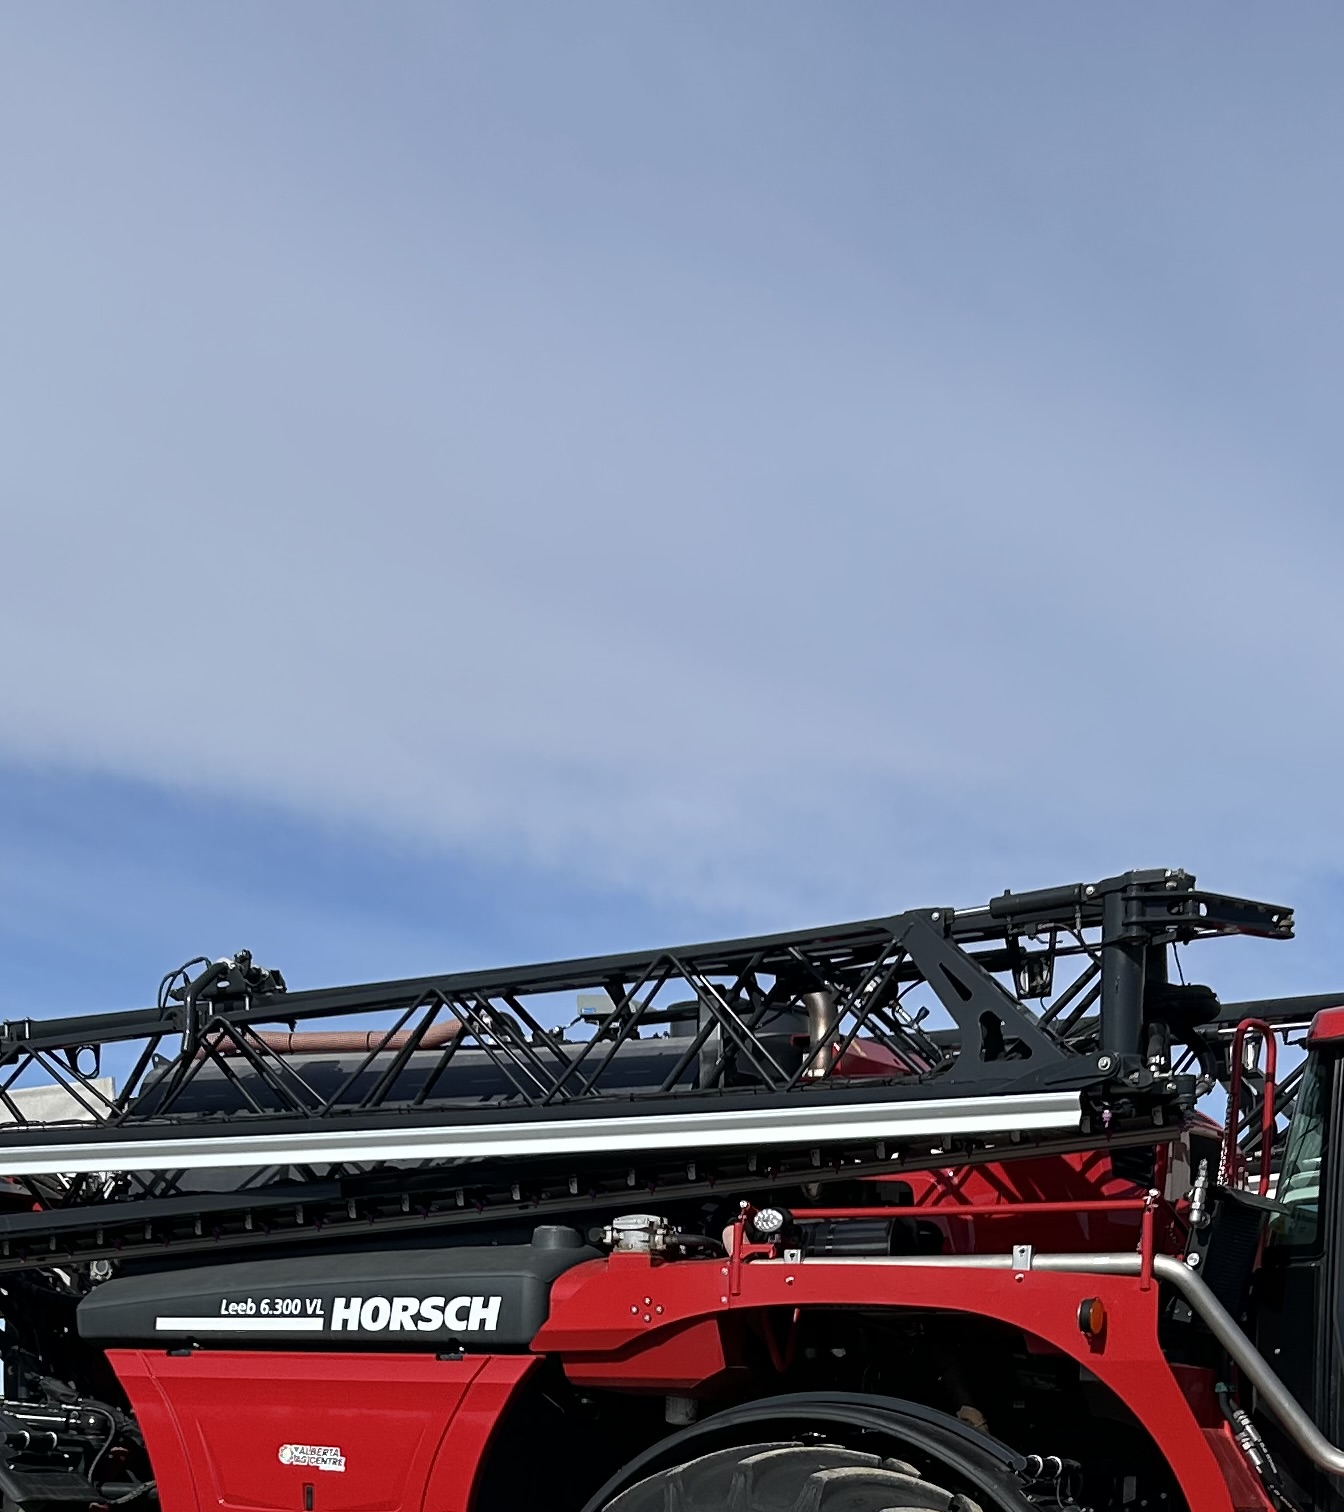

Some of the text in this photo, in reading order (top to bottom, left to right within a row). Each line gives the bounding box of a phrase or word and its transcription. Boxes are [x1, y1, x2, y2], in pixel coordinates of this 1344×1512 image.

[220, 1296, 502, 1332] Leeb 6.300 VL HORSCH
[298, 1446, 339, 1457] ALBERTA
[309, 1456, 343, 1467] CENTRE
